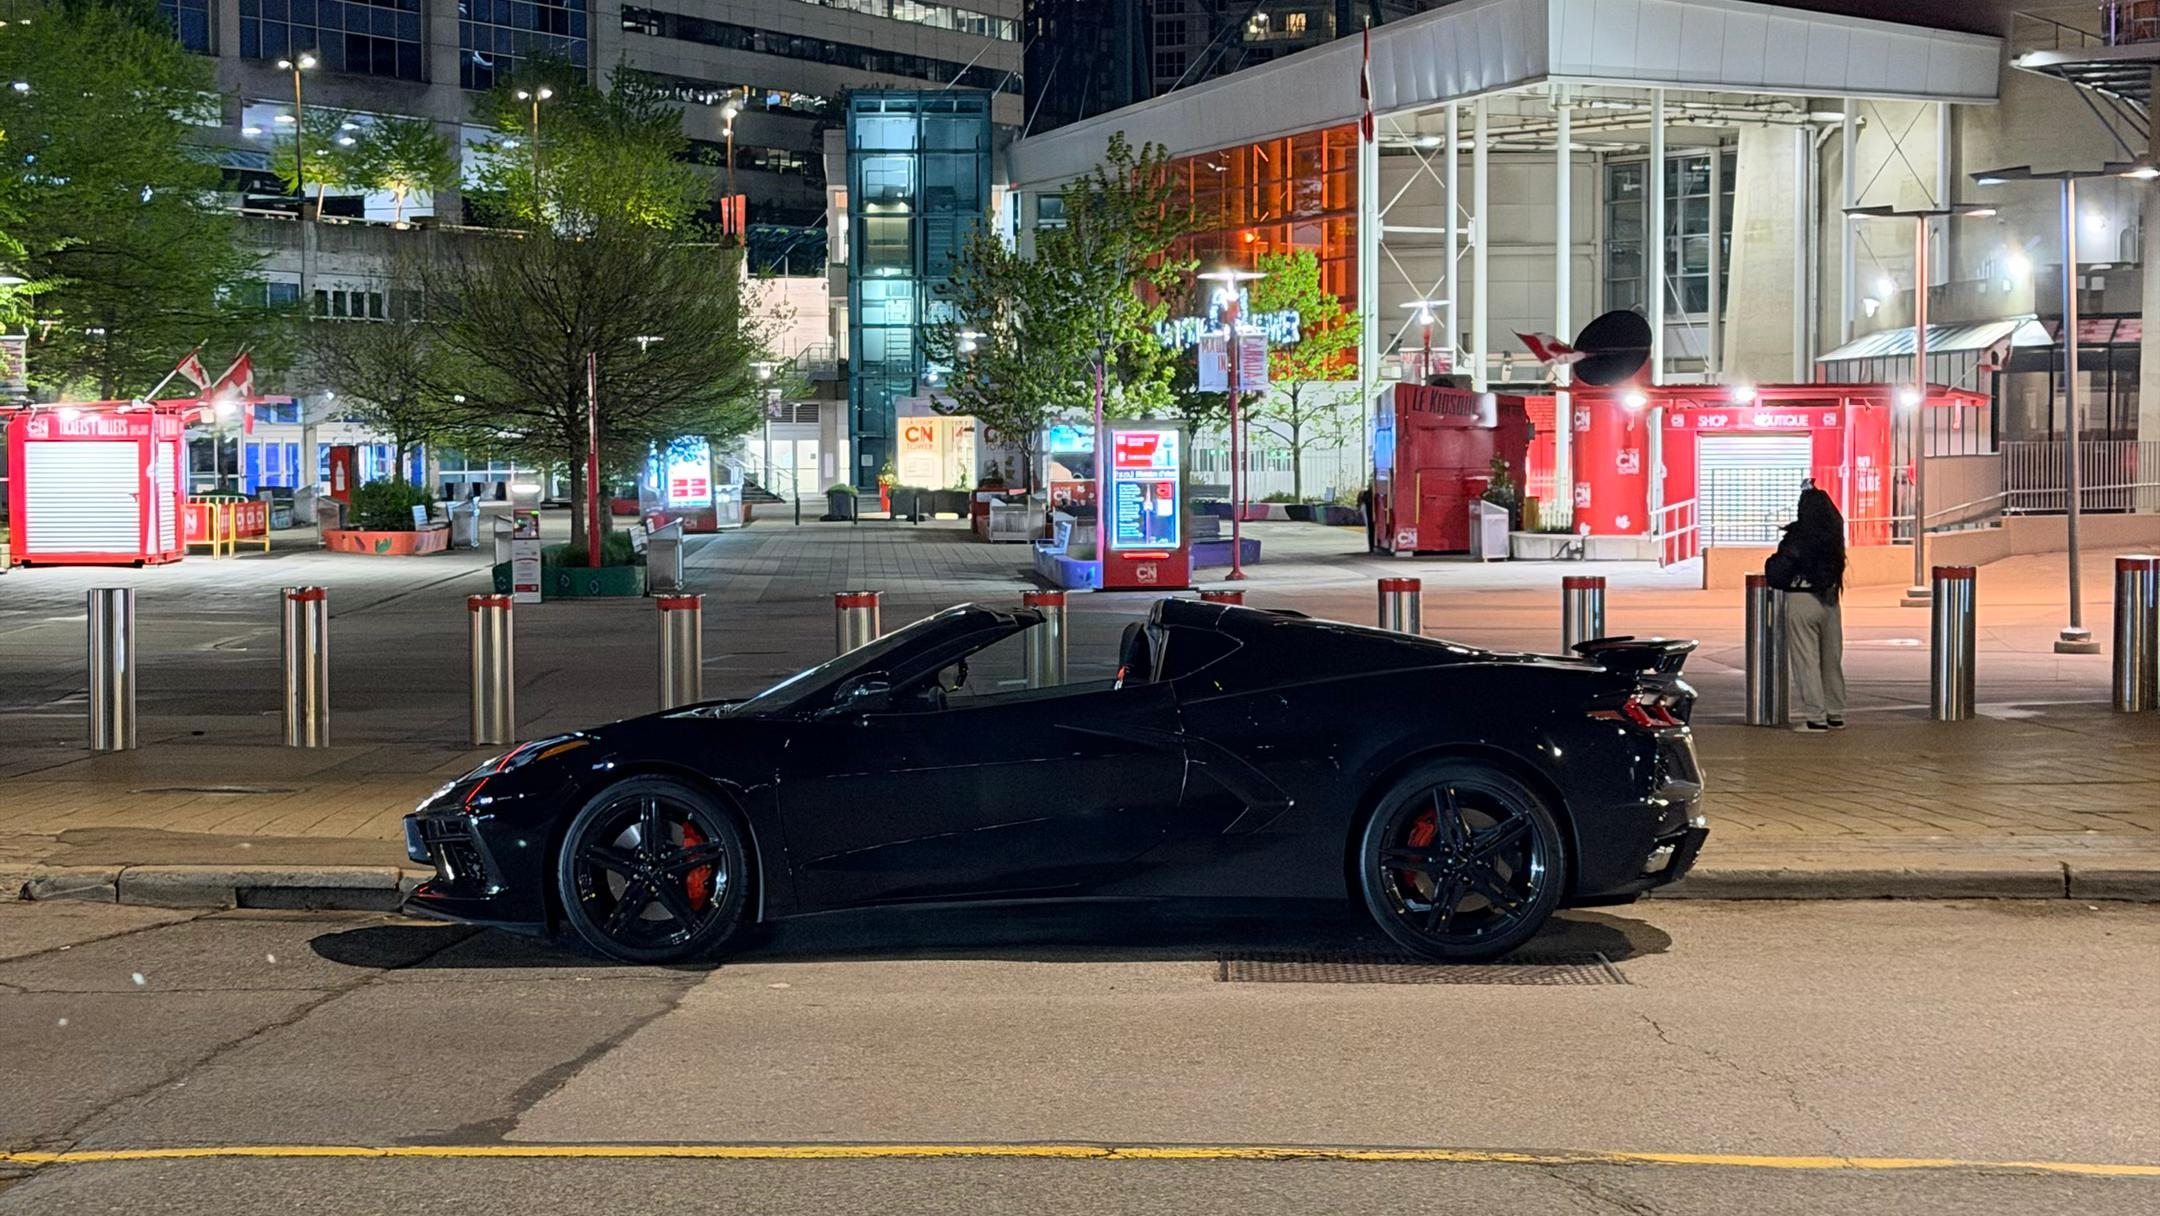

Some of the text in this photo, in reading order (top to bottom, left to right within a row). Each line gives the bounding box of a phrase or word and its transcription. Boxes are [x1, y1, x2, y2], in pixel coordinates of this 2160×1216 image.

[1412, 386, 1425, 412] LE
[1697, 415, 1729, 427] SHOP
[905, 426, 933, 442] CN
[1615, 454, 1640, 467] CN
[1397, 532, 1418, 545] CN
[1135, 567, 1157, 579] CN
